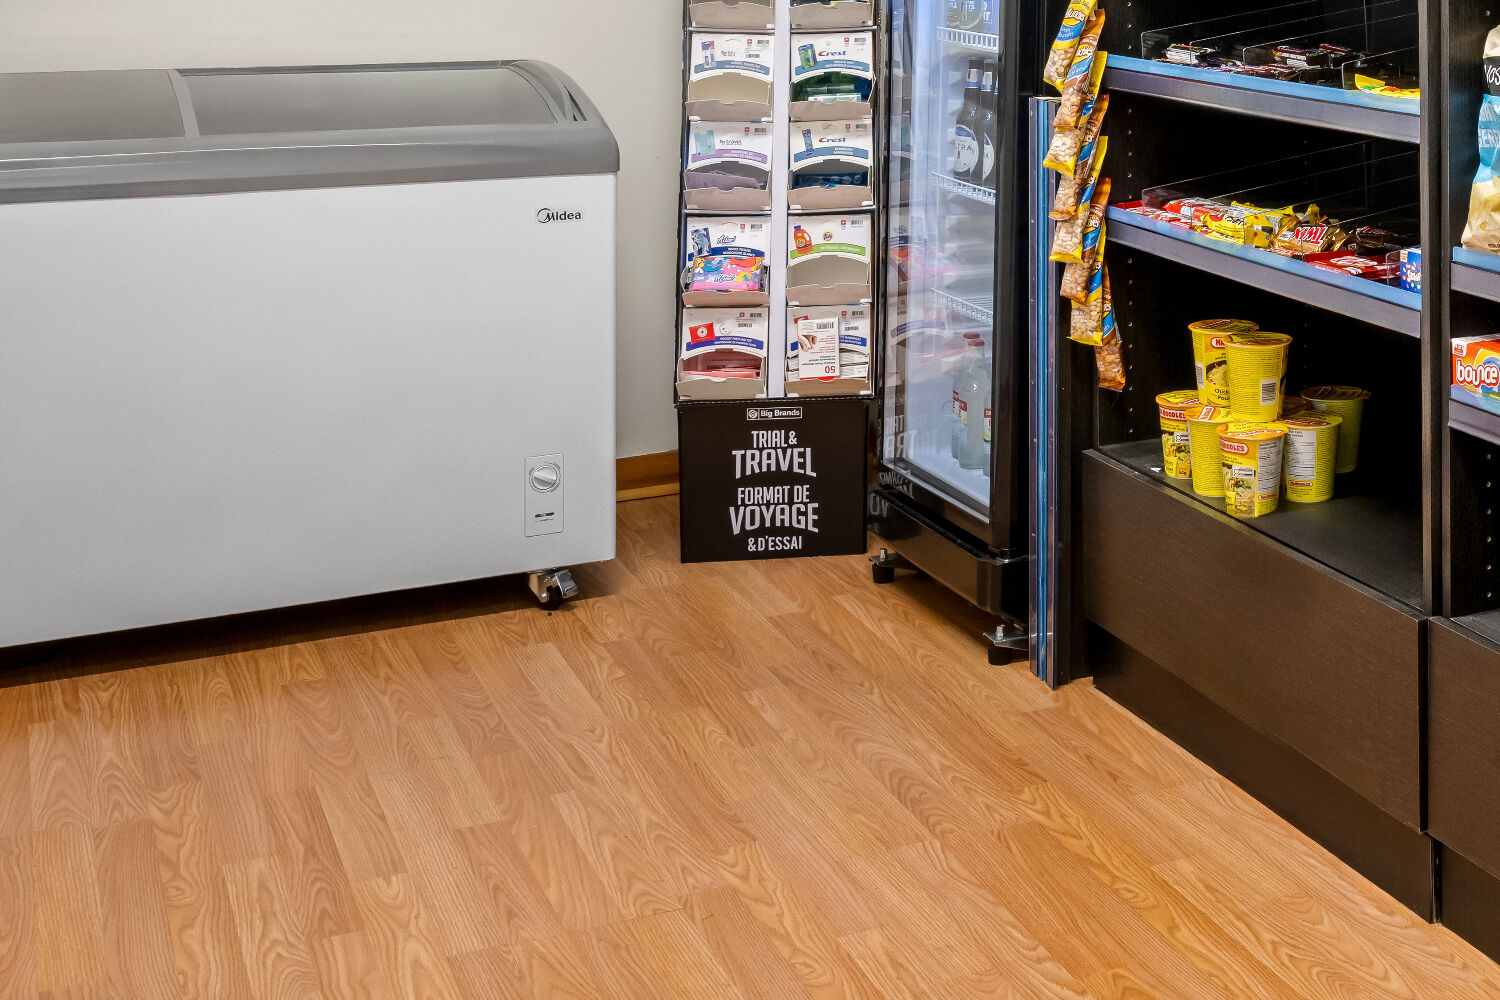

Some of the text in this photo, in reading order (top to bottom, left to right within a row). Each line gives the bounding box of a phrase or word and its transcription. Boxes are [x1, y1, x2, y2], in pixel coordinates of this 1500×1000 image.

[537, 208, 582, 223] Midea
[1293, 226, 1328, 245] TWIX
[825, 365, 836, 374] 50
[1456, 358, 1500, 388] bounce
[761, 408, 800, 418] Big Brands
[751, 430, 797, 448] TRIAL &
[732, 447, 817, 479] TRAVEL
[737, 485, 810, 505] FORMAT DE
[729, 503, 819, 536] VOYAGE
[748, 536, 803, 551] & D'ESSAI
